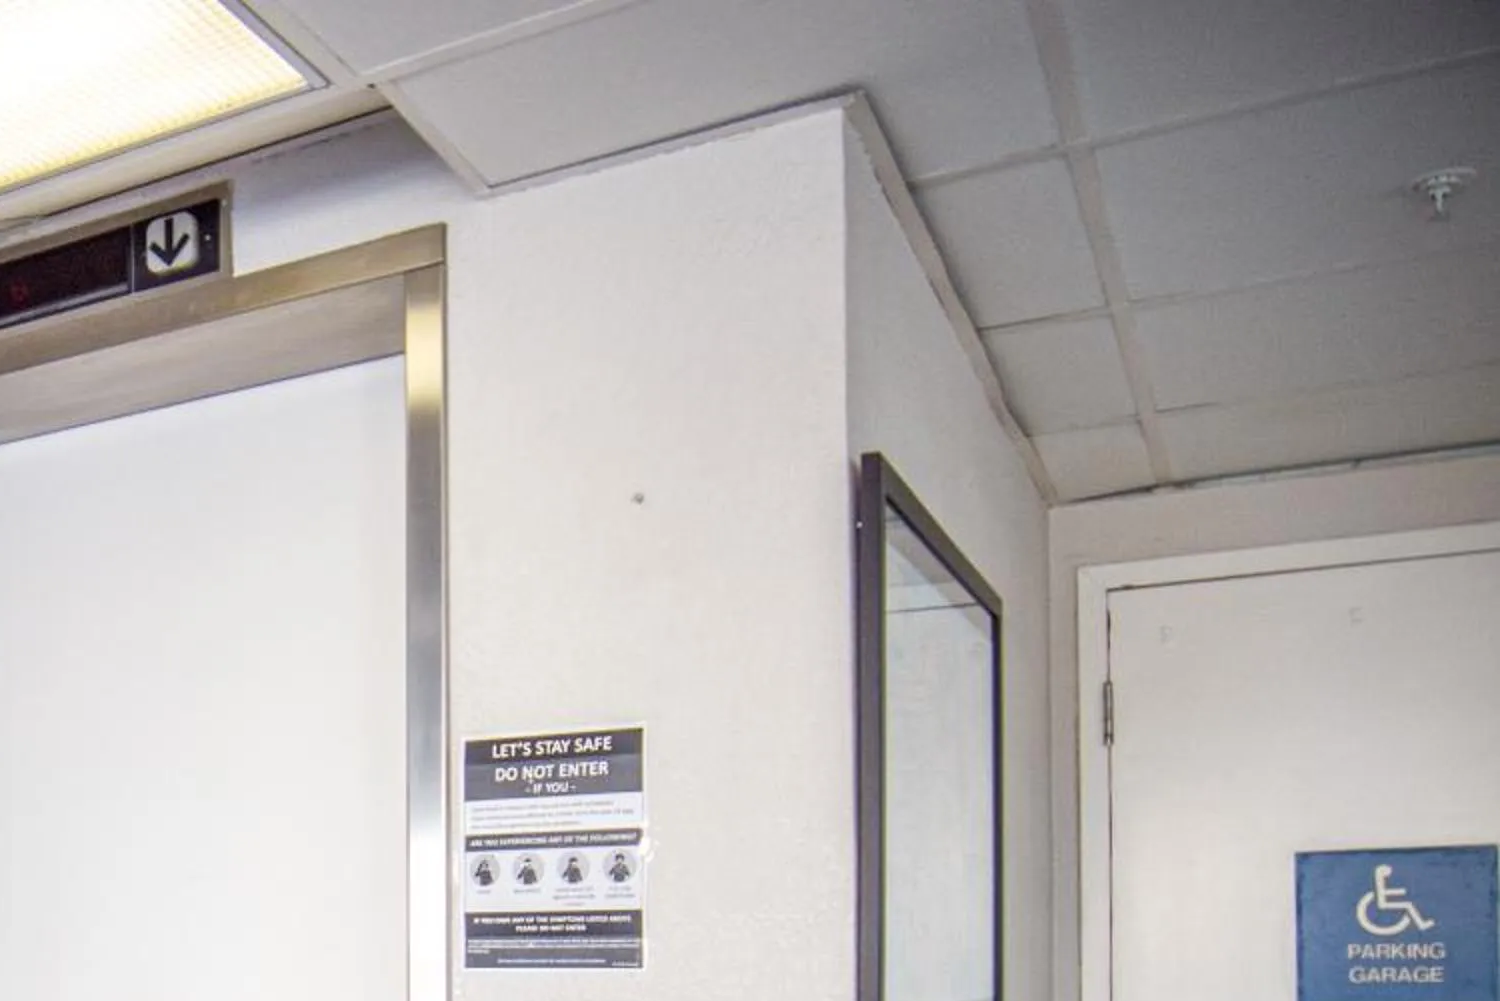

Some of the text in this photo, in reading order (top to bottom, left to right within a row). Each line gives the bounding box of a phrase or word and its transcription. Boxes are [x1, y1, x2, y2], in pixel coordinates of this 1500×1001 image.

[492, 736, 613, 759] LET'S STAY SAFE
[494, 761, 609, 782] DO NOT ENTER
[533, 781, 569, 794] IF YOU
[1347, 942, 1446, 960] PARKING
[1348, 966, 1444, 984] GARAGE
